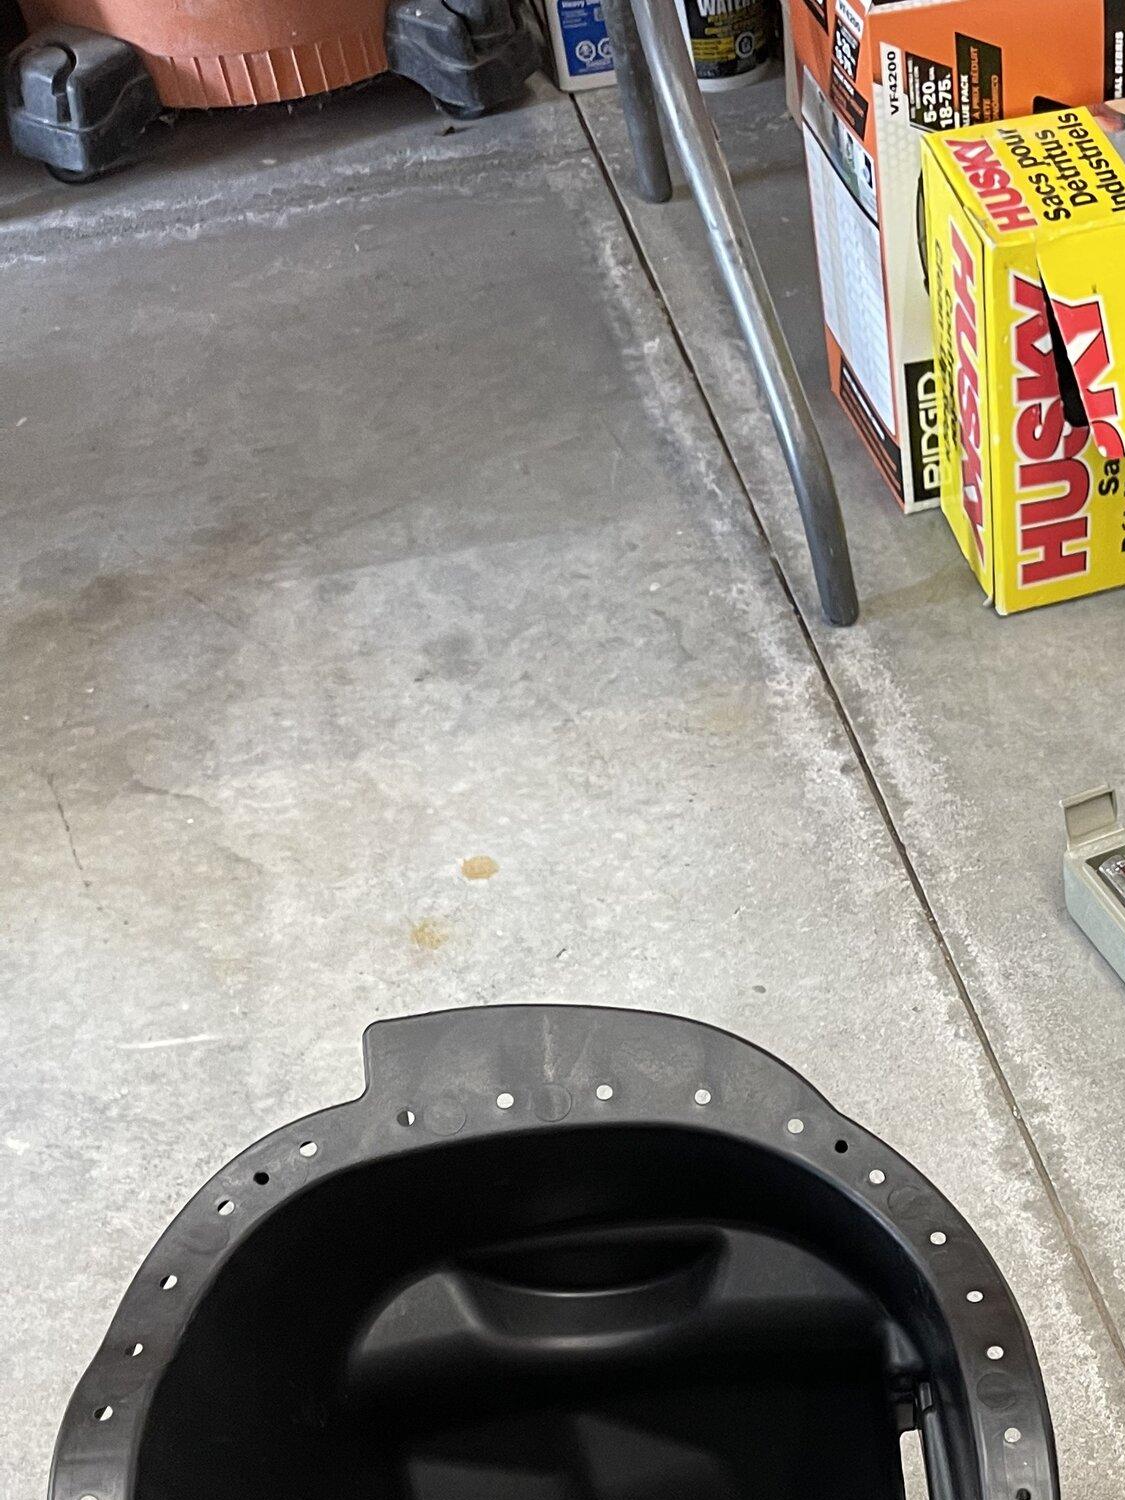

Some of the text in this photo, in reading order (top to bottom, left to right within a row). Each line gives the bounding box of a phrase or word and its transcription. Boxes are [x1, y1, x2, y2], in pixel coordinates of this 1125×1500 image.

[886, 51, 899, 115] VF4200
[922, 82, 936, 124] 5-20
[938, 79, 953, 127] 18-75
[960, 104, 971, 126] ALUE
[944, 138, 1038, 232] HUSKY
[997, 128, 1072, 222] Sacs pour
[1035, 129, 1098, 208] Détritus
[950, 223, 985, 571] HUSKY
[1098, 458, 1120, 497] Sa
